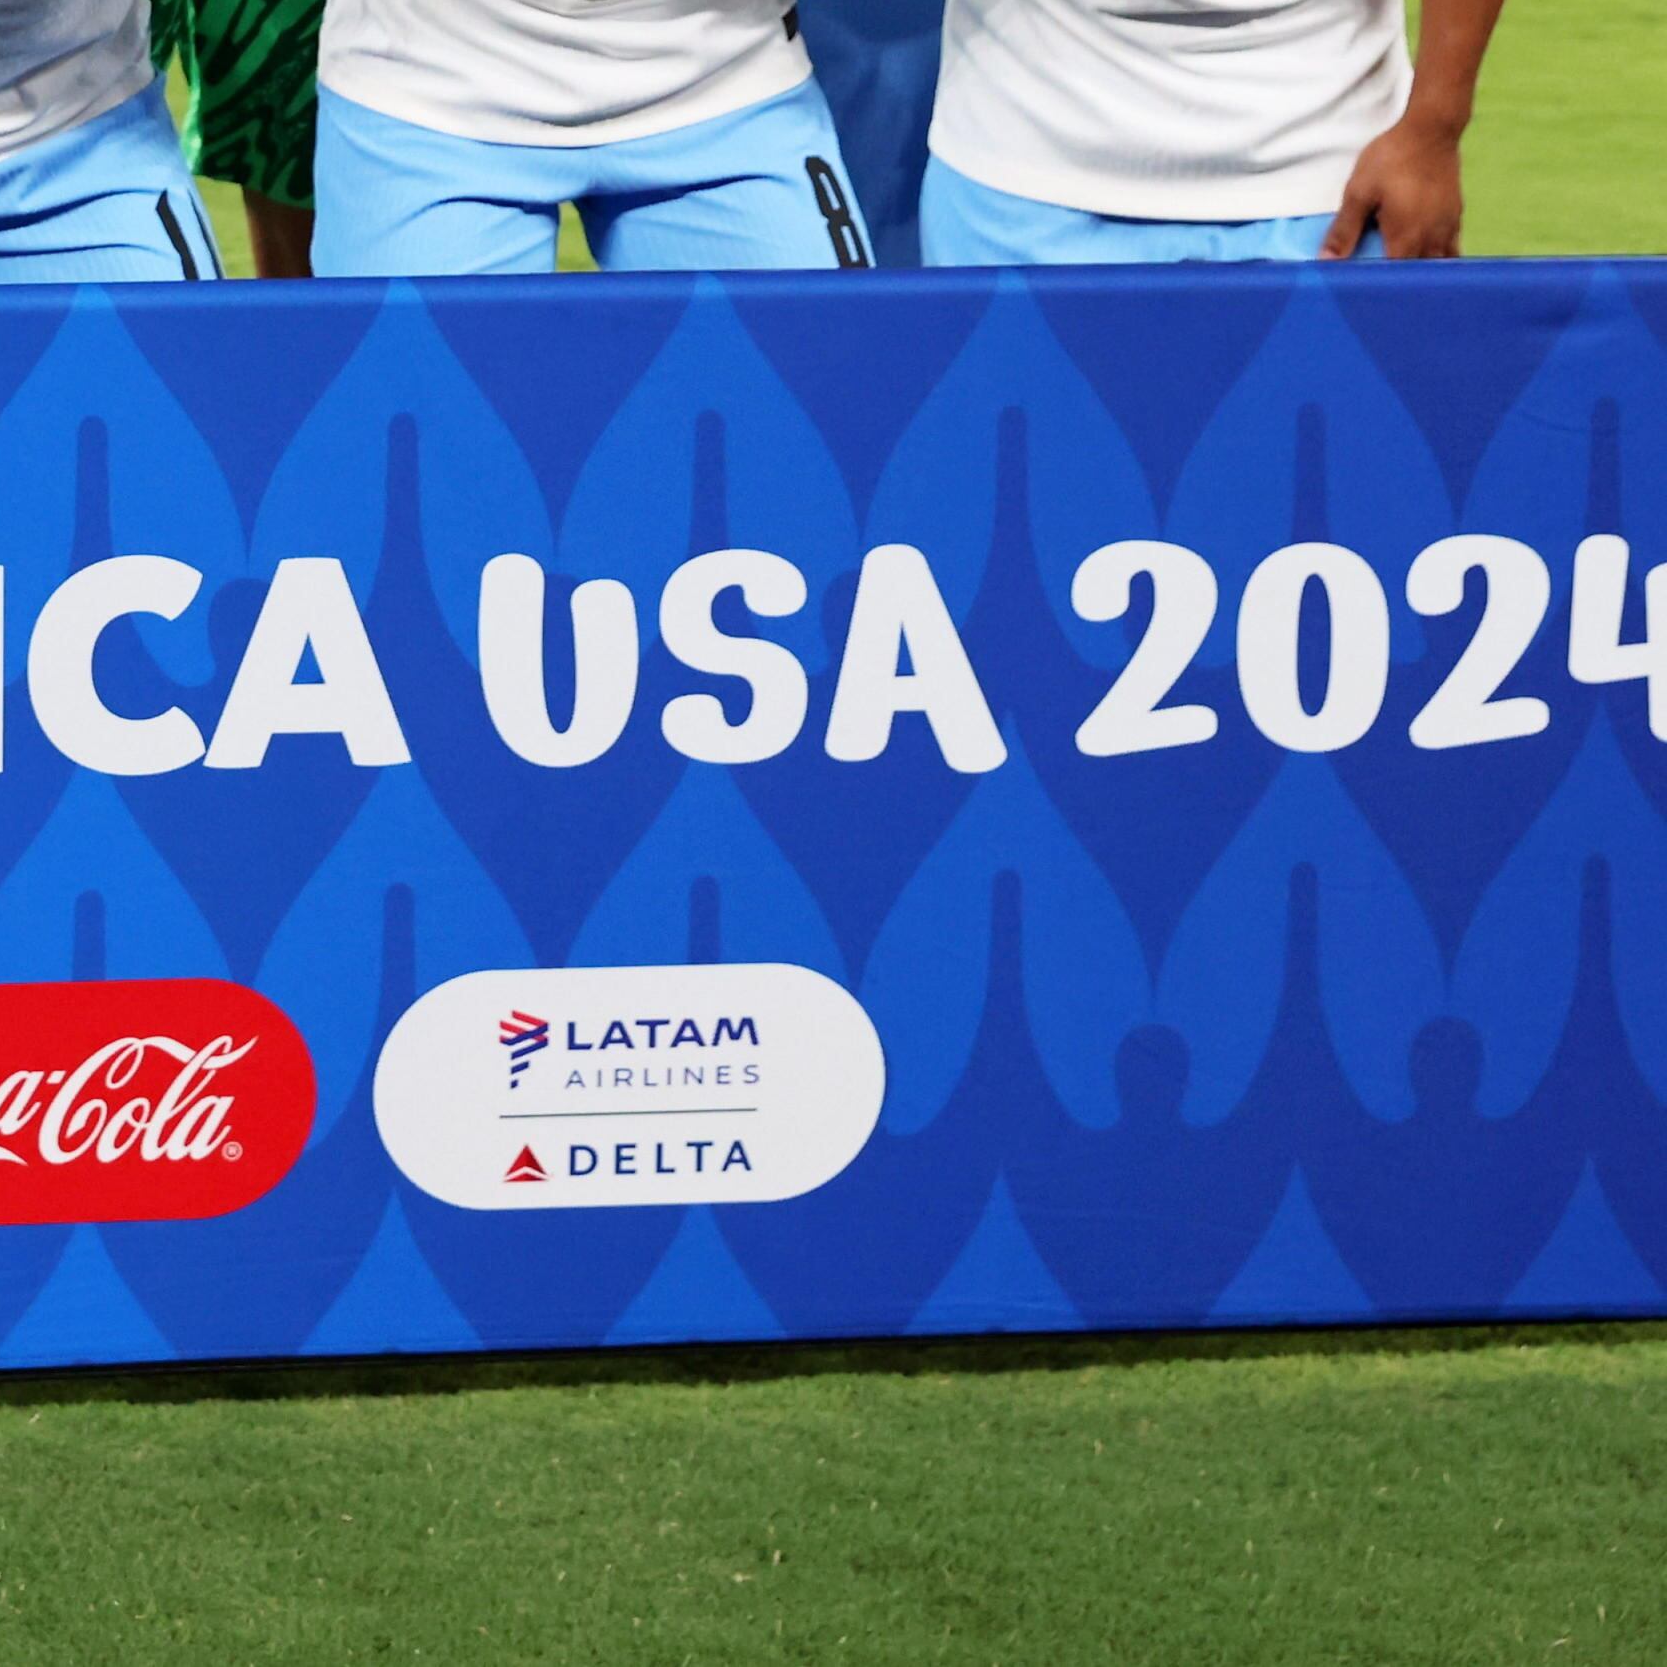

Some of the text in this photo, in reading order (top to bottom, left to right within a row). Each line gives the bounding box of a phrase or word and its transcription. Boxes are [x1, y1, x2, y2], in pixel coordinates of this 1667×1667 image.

[806, 156, 870, 268] 8
[479, 545, 1008, 773] USA
[1071, 534, 1667, 757] 2024
[567, 1016, 760, 1051] LATAM
[565, 1064, 760, 1089] AIRLINES
[569, 1140, 752, 1177] DELTA
